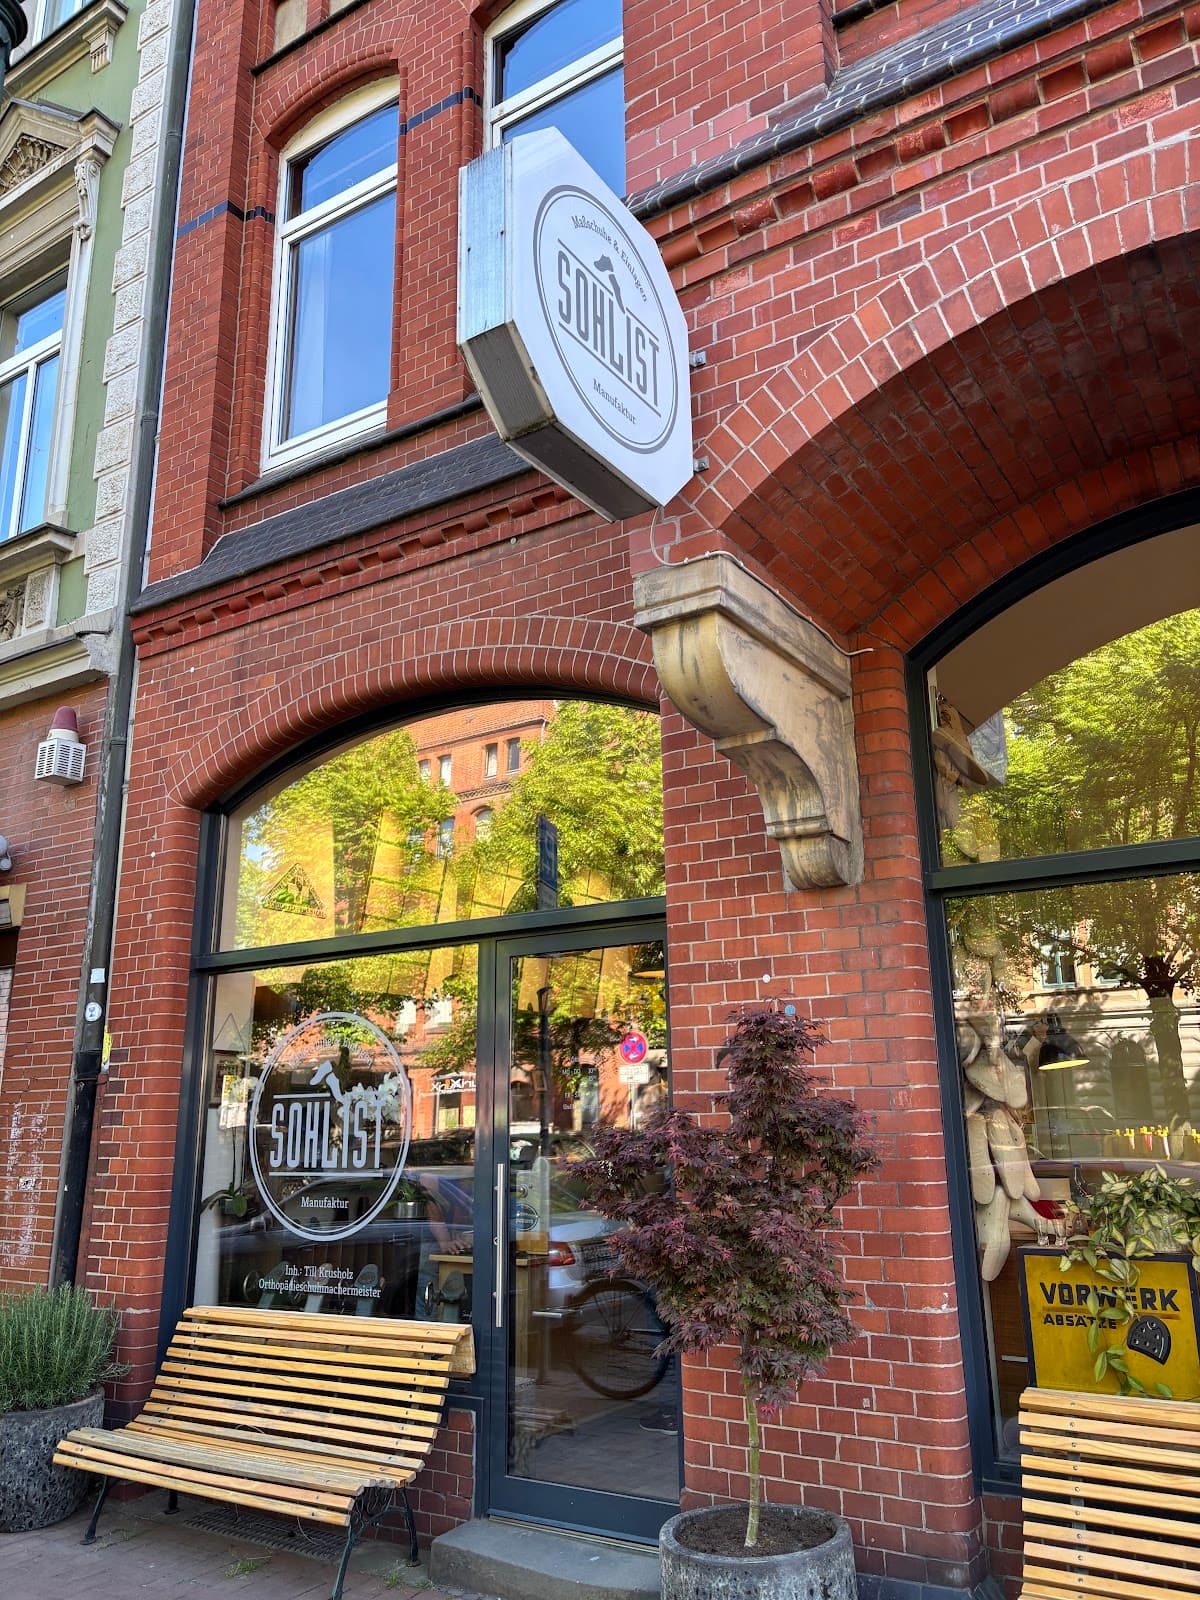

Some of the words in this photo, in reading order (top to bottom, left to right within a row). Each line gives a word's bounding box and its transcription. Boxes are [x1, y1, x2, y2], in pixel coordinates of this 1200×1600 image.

[613, 240, 620, 254] &
[621, 249, 647, 302] Einlagen
[558, 250, 660, 407] SOHLIST
[593, 378, 637, 424] Manufaktur
[270, 1100, 383, 1168] SOHLIST
[301, 1196, 349, 1209] Manufaktur
[258, 1278, 381, 1298] Orthopädieschuhmachermeister
[304, 1265, 317, 1278] Till
[319, 1266, 354, 1280] Krusholz
[1039, 1281, 1180, 1312] VORWERK
